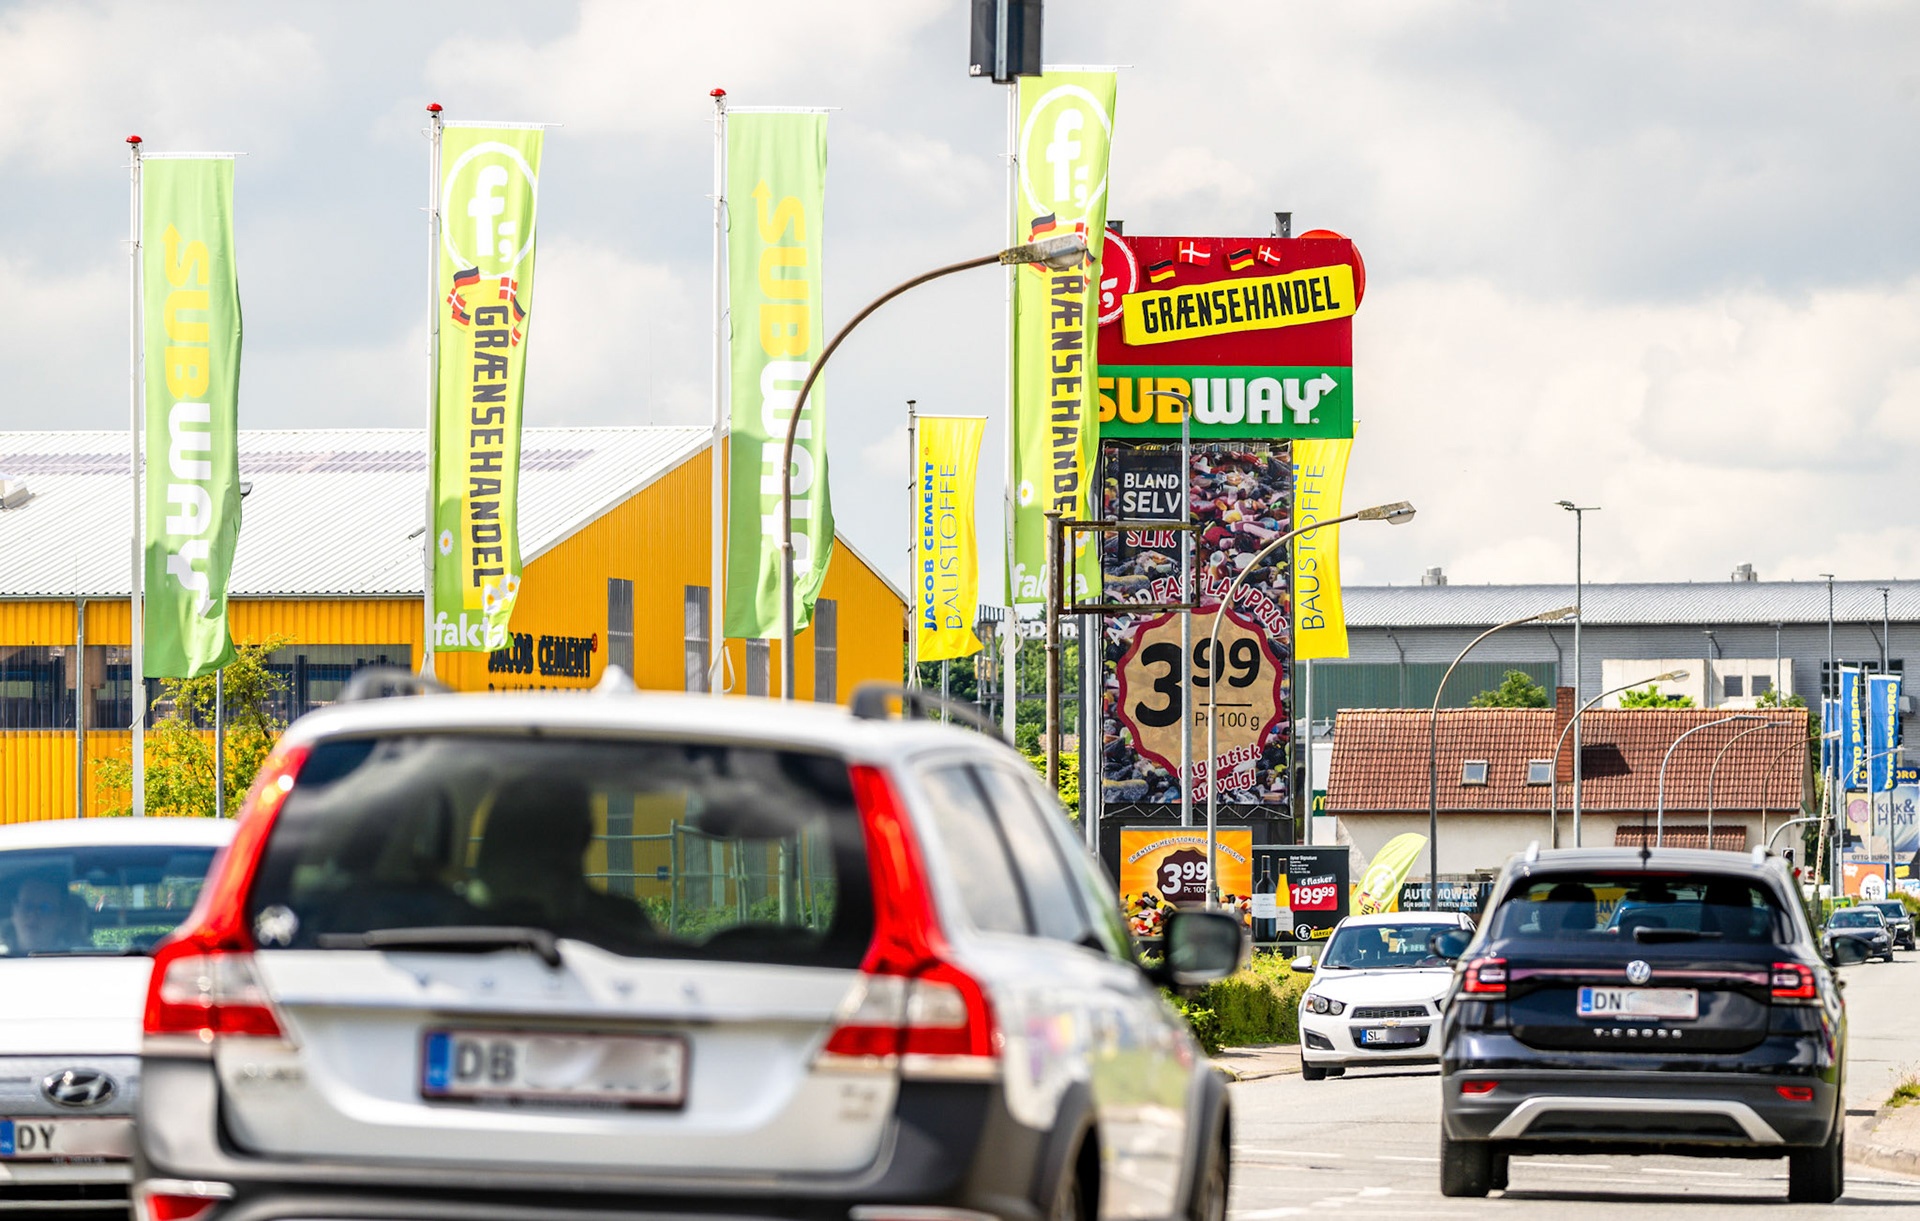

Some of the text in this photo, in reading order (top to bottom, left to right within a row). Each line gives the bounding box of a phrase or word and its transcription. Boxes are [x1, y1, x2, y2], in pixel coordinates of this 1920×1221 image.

[1142, 275, 1340, 334] GRÆNSEHANDEL
[751, 178, 815, 578] SUBWAY
[1098, 373, 1339, 424] SUBWAY
[161, 222, 217, 618] SUBWAY
[469, 305, 509, 588] GRÆNSEHANDEL
[1123, 473, 1179, 489] BLAND
[1123, 491, 1181, 513] SELV
[924, 462, 937, 631] JACOB CEMENT
[939, 464, 963, 629] BAUSTOFFE
[1126, 530, 1177, 548] SLIK
[1298, 465, 1325, 630] BAUSTOFFE
[1014, 563, 1088, 598] faka
[1206, 575, 1250, 602] LAV
[1243, 589, 1288, 636] PRIS
[434, 611, 507, 647] fakta
[488, 633, 593, 678] JACOB CEMENT
[1219, 712, 1247, 727] 100
[1250, 716, 1260, 731] g
[1177, 743, 1263, 778] igntisk
[1307, 875, 1333, 886] flasker
[1594, 992, 1622, 1010] DN
[1367, 1031, 1381, 1041] SL
[455, 1041, 516, 1082] DB
[17, 1125, 56, 1150] DY
